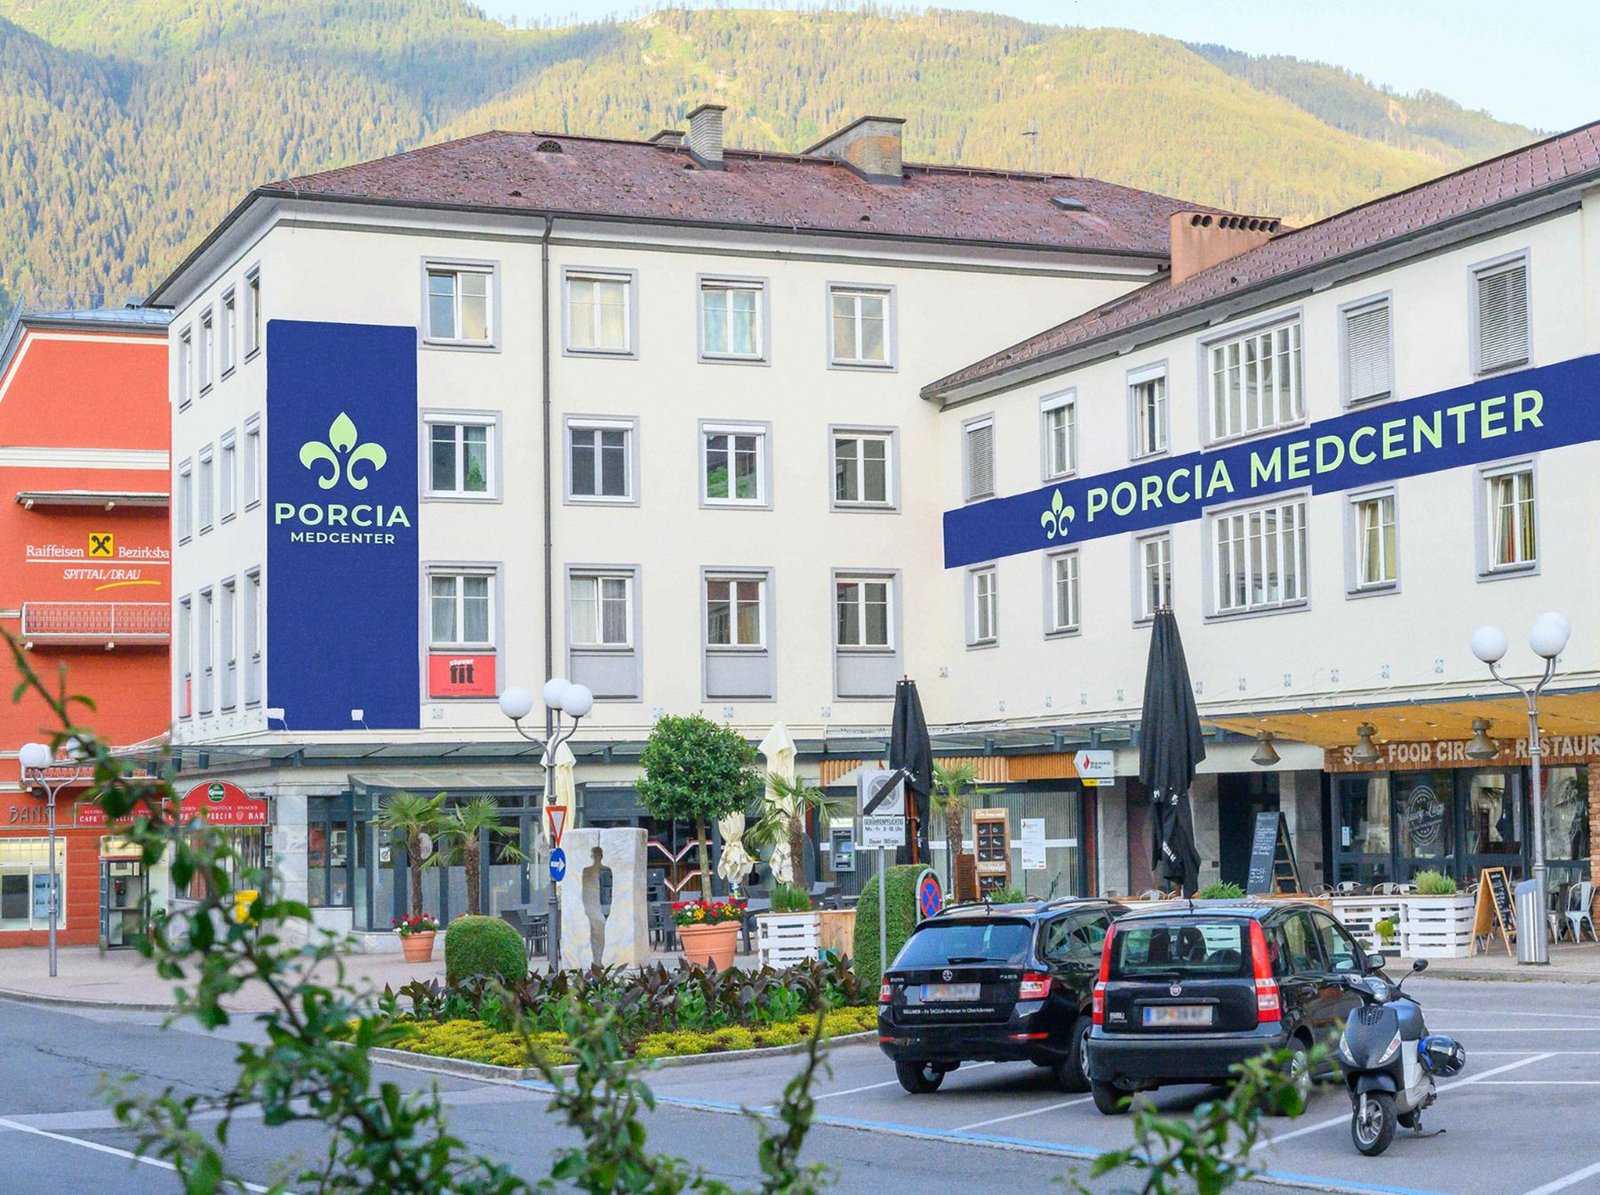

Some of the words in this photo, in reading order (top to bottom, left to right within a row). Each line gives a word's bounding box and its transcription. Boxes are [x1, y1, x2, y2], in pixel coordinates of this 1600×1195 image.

[1086, 459, 1235, 523] PORCIA
[1249, 389, 1545, 488] MEDCENTER
[274, 502, 411, 528] PORCIA
[290, 531, 396, 545] MEDCENTER
[25, 545, 85, 558] Raiffeisen
[63, 569, 142, 580] SPITTAL/DRAU
[1388, 742, 1431, 764] FOOD
[248, 812, 265, 820] BAR
